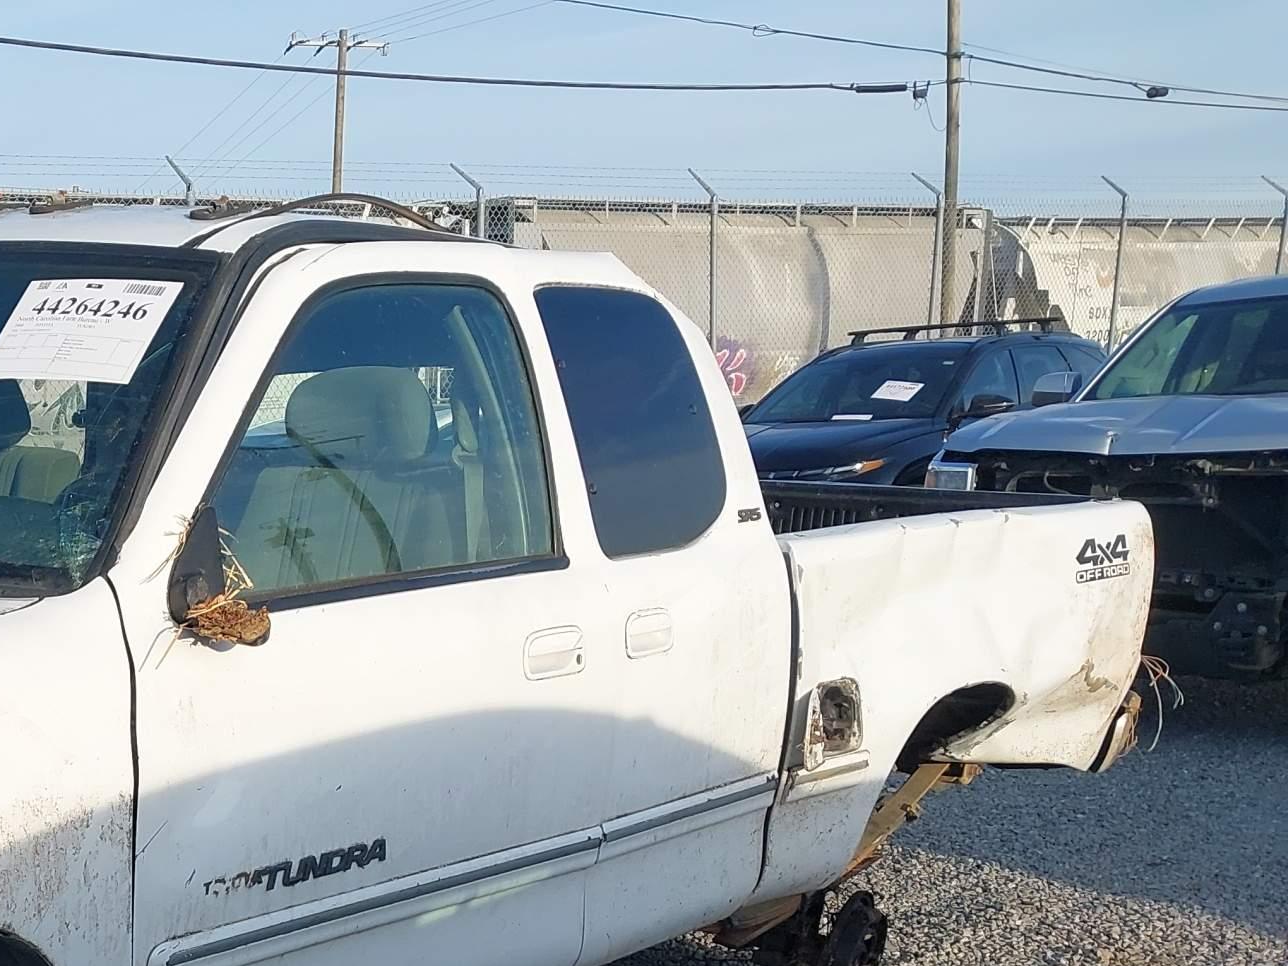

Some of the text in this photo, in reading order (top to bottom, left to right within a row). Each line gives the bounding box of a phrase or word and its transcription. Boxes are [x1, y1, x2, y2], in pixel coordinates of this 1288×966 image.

[32, 296, 154, 321] 44264246
[1076, 564, 1130, 583] OFF ROAD
[260, 837, 387, 892] TUNDRA
